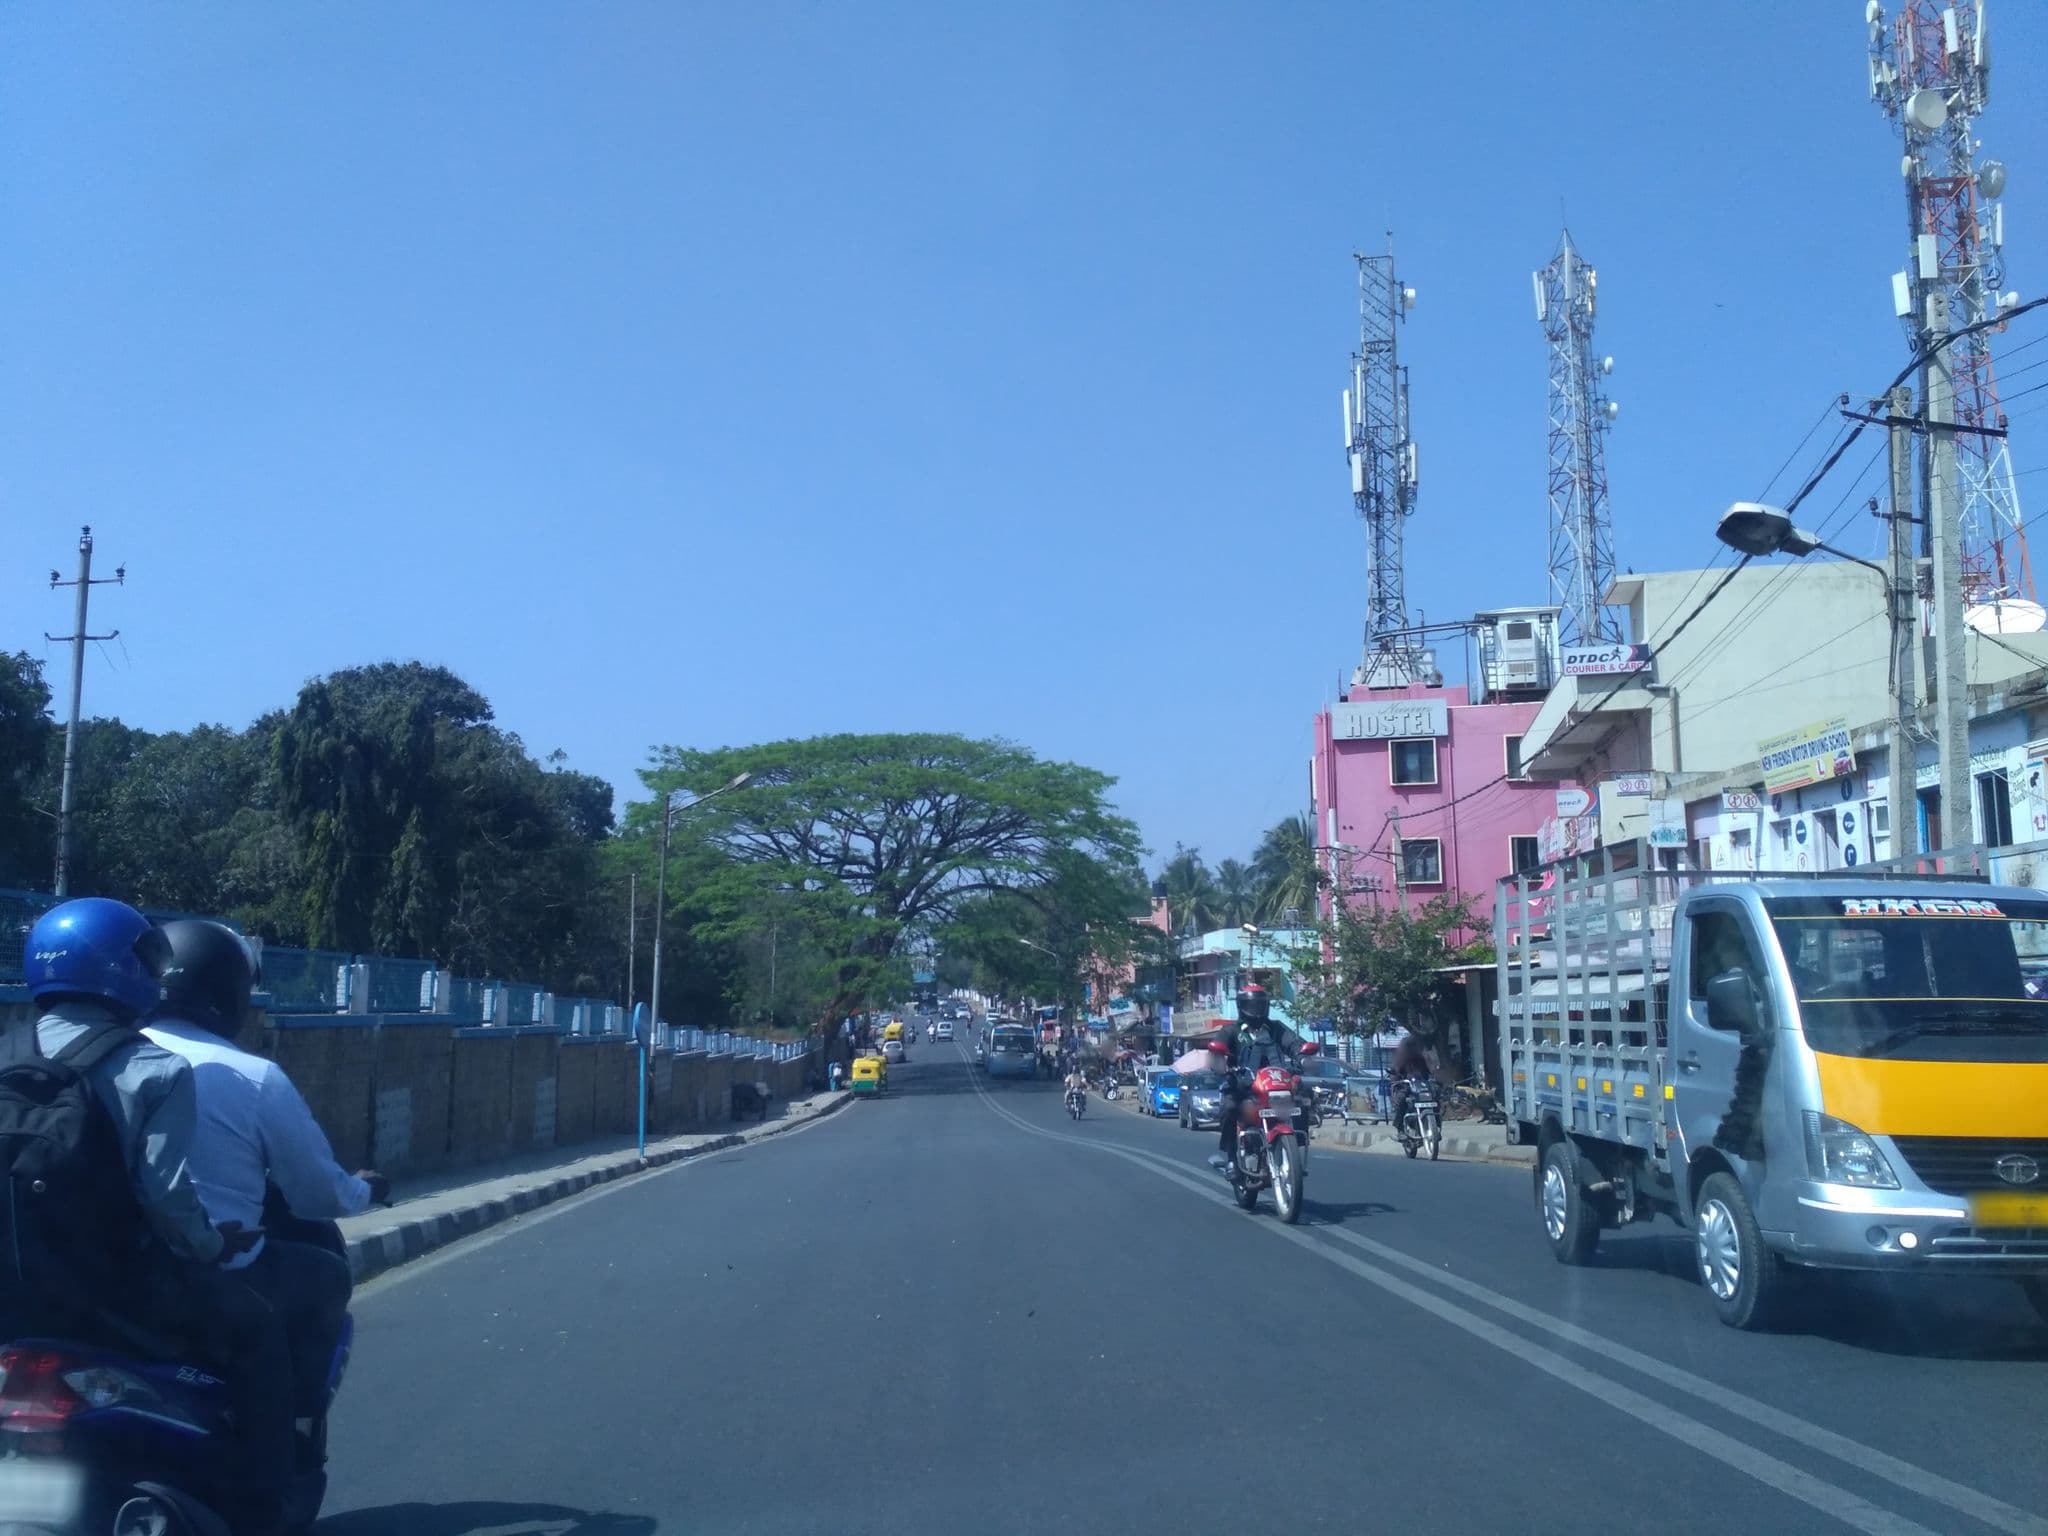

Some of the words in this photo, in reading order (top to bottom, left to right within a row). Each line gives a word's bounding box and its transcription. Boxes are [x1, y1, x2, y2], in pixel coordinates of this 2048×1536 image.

[1566, 653, 1610, 664] DTDC
[1566, 664, 1606, 674] COURIER
[1345, 711, 1436, 738] HOSTEL
[1771, 748, 1792, 769] FRIENDS
[1791, 742, 1808, 763] MOTOR
[1807, 736, 1830, 759] DRIVING
[1828, 730, 1850, 753] SCHOOL
